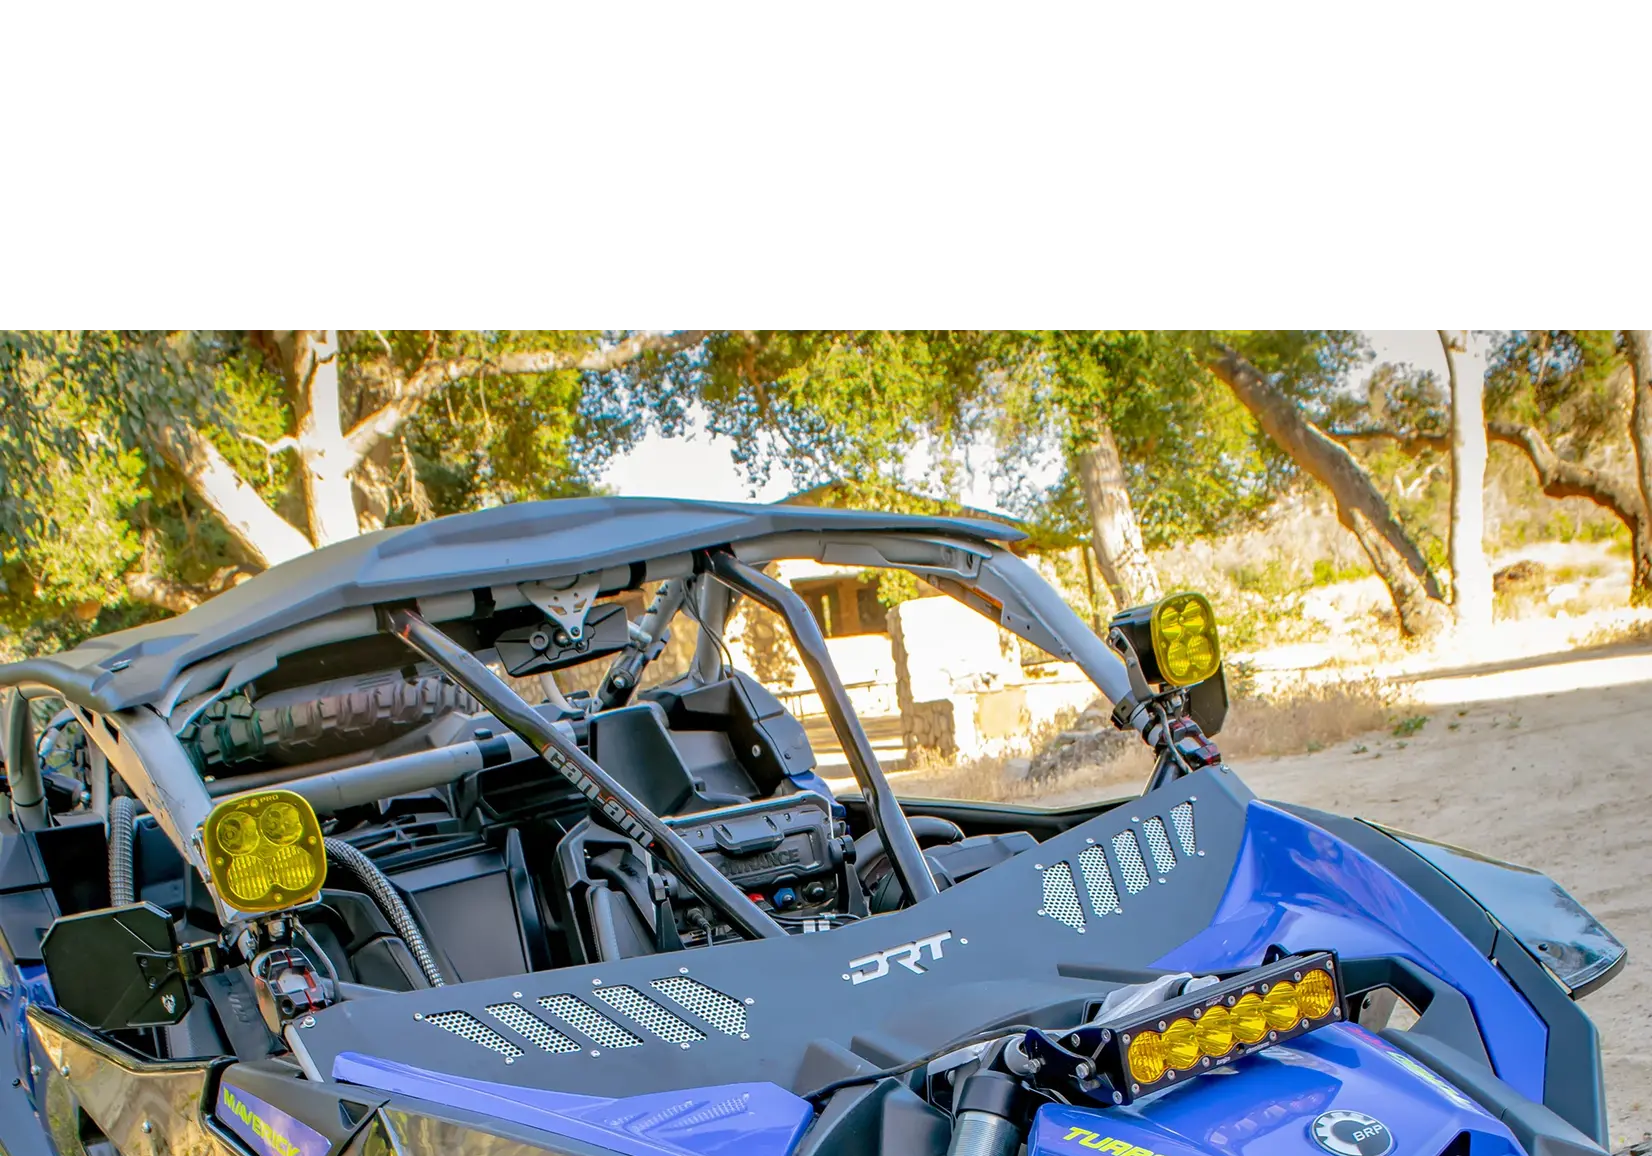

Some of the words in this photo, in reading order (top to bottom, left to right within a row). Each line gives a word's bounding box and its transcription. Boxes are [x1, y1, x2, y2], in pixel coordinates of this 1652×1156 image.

[260, 794, 279, 803] PRO
[542, 744, 654, 848] can-am
[849, 930, 952, 985] DRT
[1353, 1124, 1383, 1142] BRP
